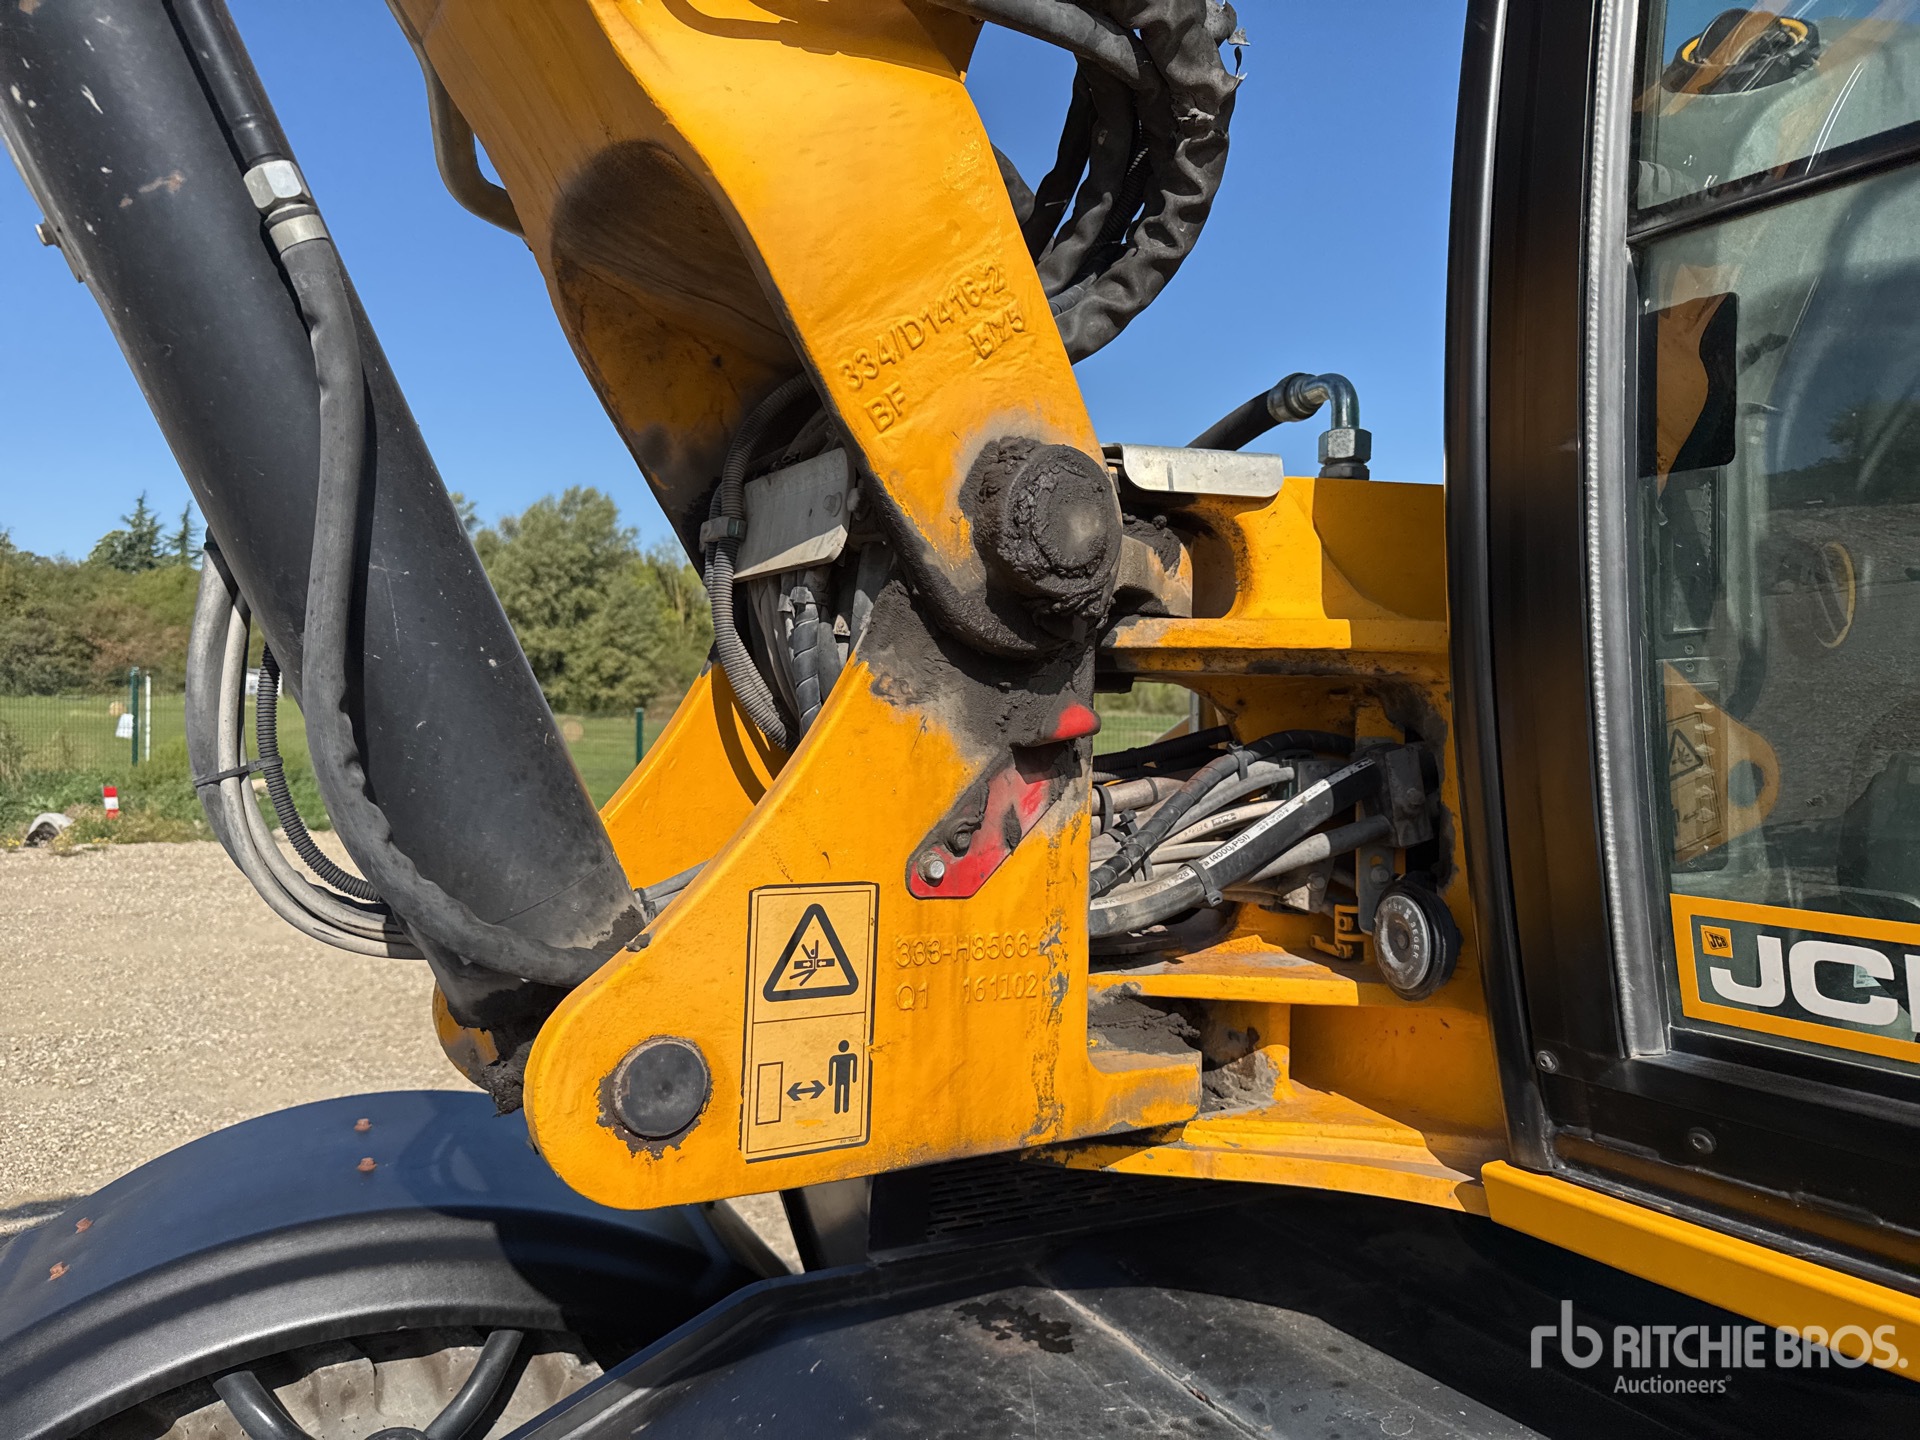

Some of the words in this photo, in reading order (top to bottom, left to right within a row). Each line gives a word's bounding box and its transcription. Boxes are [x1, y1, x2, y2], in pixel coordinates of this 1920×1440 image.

[864, 382, 907, 433] BF
[1709, 933, 1727, 948] JCB
[896, 981, 928, 1011] Q1
